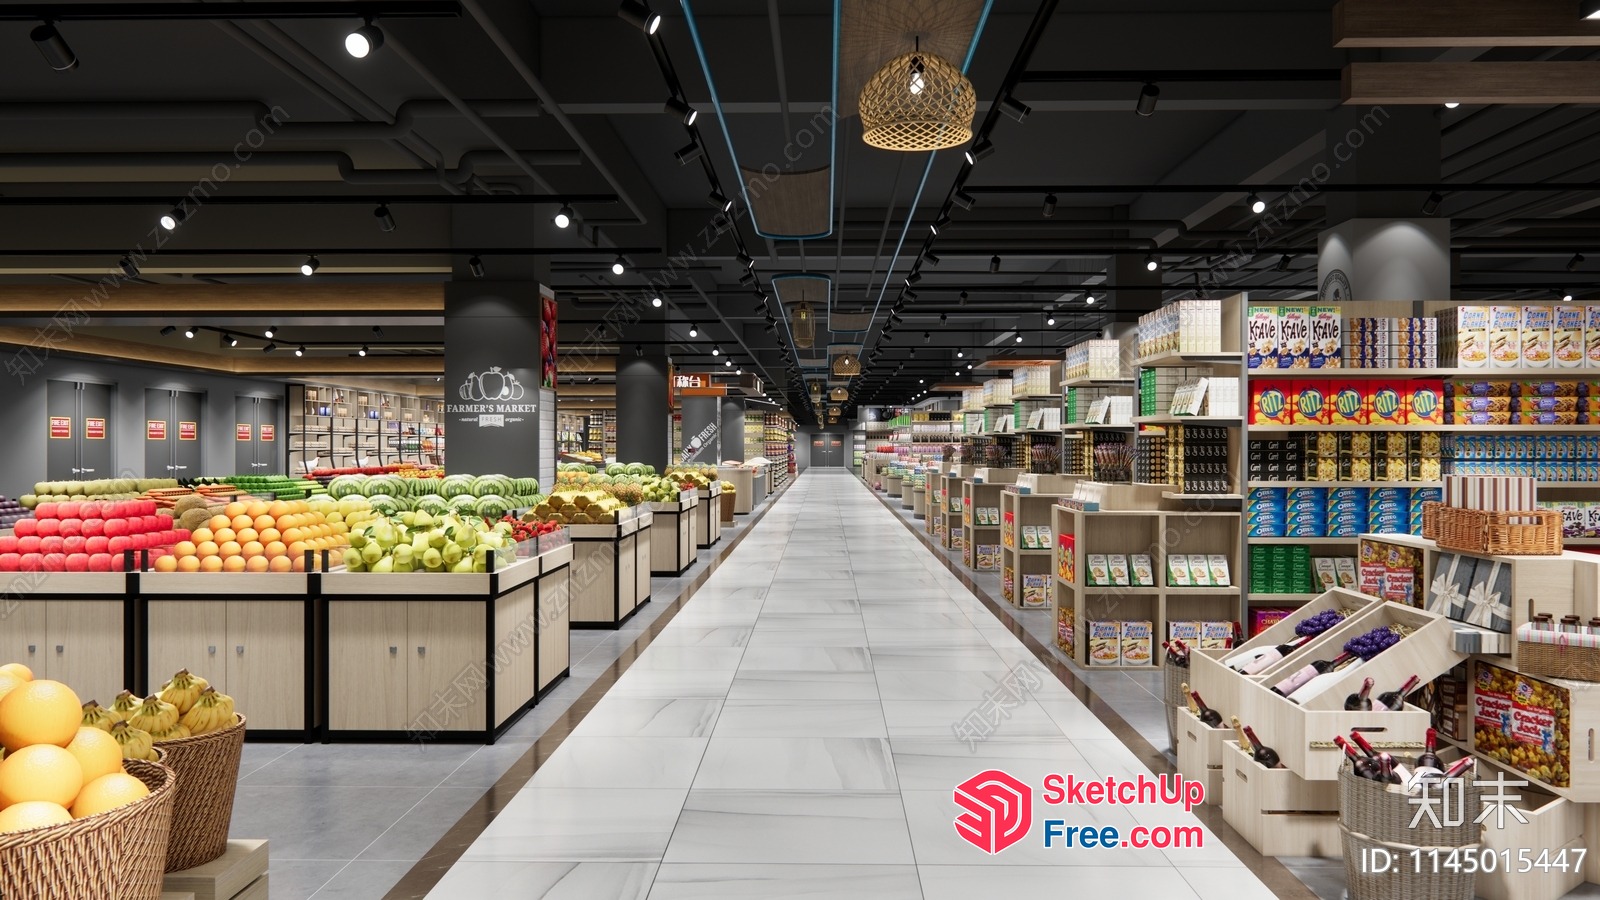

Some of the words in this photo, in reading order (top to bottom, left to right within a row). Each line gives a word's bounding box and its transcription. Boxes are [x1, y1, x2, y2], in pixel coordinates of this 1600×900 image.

[447, 404, 494, 413] FARMER'S
[496, 404, 536, 413] MARKET
[1262, 391, 1284, 412] RITZ
[1300, 391, 1322, 412] RITZ
[1338, 391, 1360, 412] RITZ
[1376, 391, 1398, 412] RITZ
[1414, 391, 1436, 412] RITZ
[698, 422, 718, 442] FRESH
[1362, 568, 1385, 576] Cracker
[1364, 576, 1378, 584] Jack
[1389, 582, 1405, 591] Jack
[1476, 696, 1511, 711] Cracker
[1479, 707, 1500, 720] Jack
[1514, 711, 1553, 727] Cracker
[1517, 722, 1541, 736] Jack
